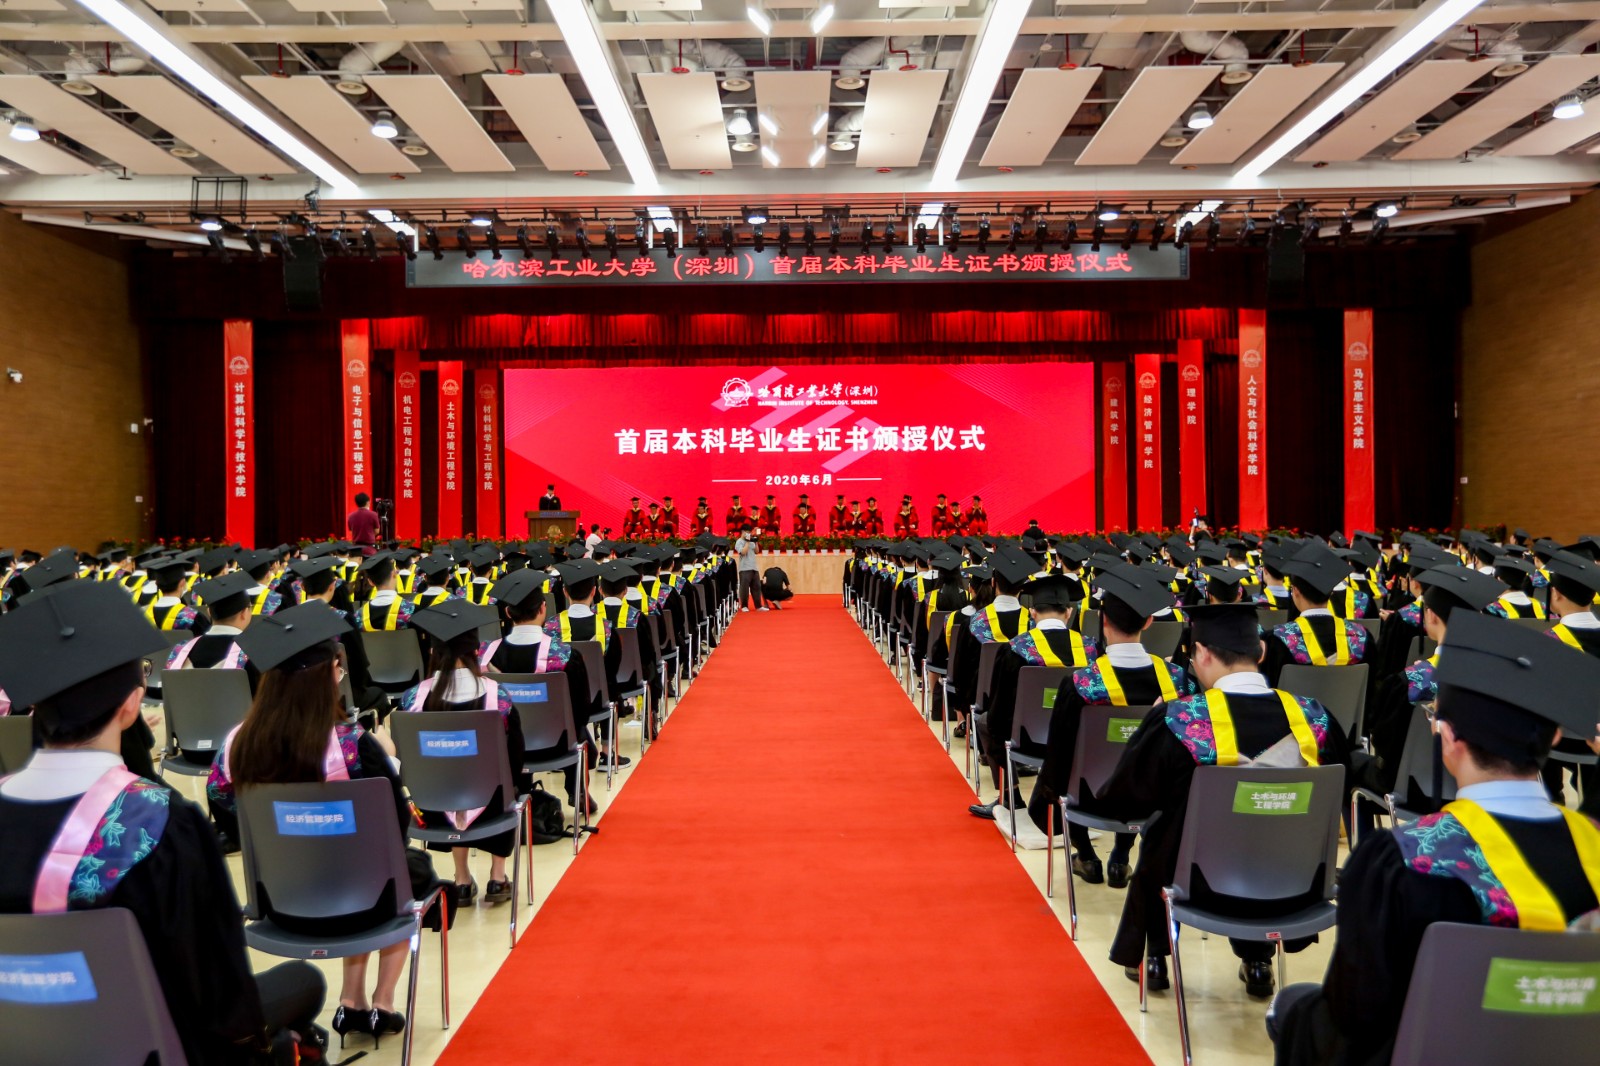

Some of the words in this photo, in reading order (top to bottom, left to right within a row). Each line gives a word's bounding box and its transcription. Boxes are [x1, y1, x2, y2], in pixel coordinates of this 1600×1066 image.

[234, 382, 246, 498] 计算机科学与技术学院
[352, 385, 364, 485] 电子与信息工程学院
[403, 395, 413, 499] 机电工程与自动化学院
[446, 402, 456, 491] 土木与环境工程学院
[614, 424, 986, 455] 首届本科毕业生证书颁授仪式
[1109, 398, 1119, 445] 建筑学院
[1143, 395, 1154, 469] 经济管理学院
[1186, 387, 1197, 425] 理学院
[1247, 375, 1259, 476] 人文与社会科学学院
[1353, 367, 1365, 449] 马克思主义学院
[482, 404, 493, 491] 材料科学与工程学院
[765, 474, 833, 486] 2020年6月
[285, 813, 344, 823] 经济管理学院
